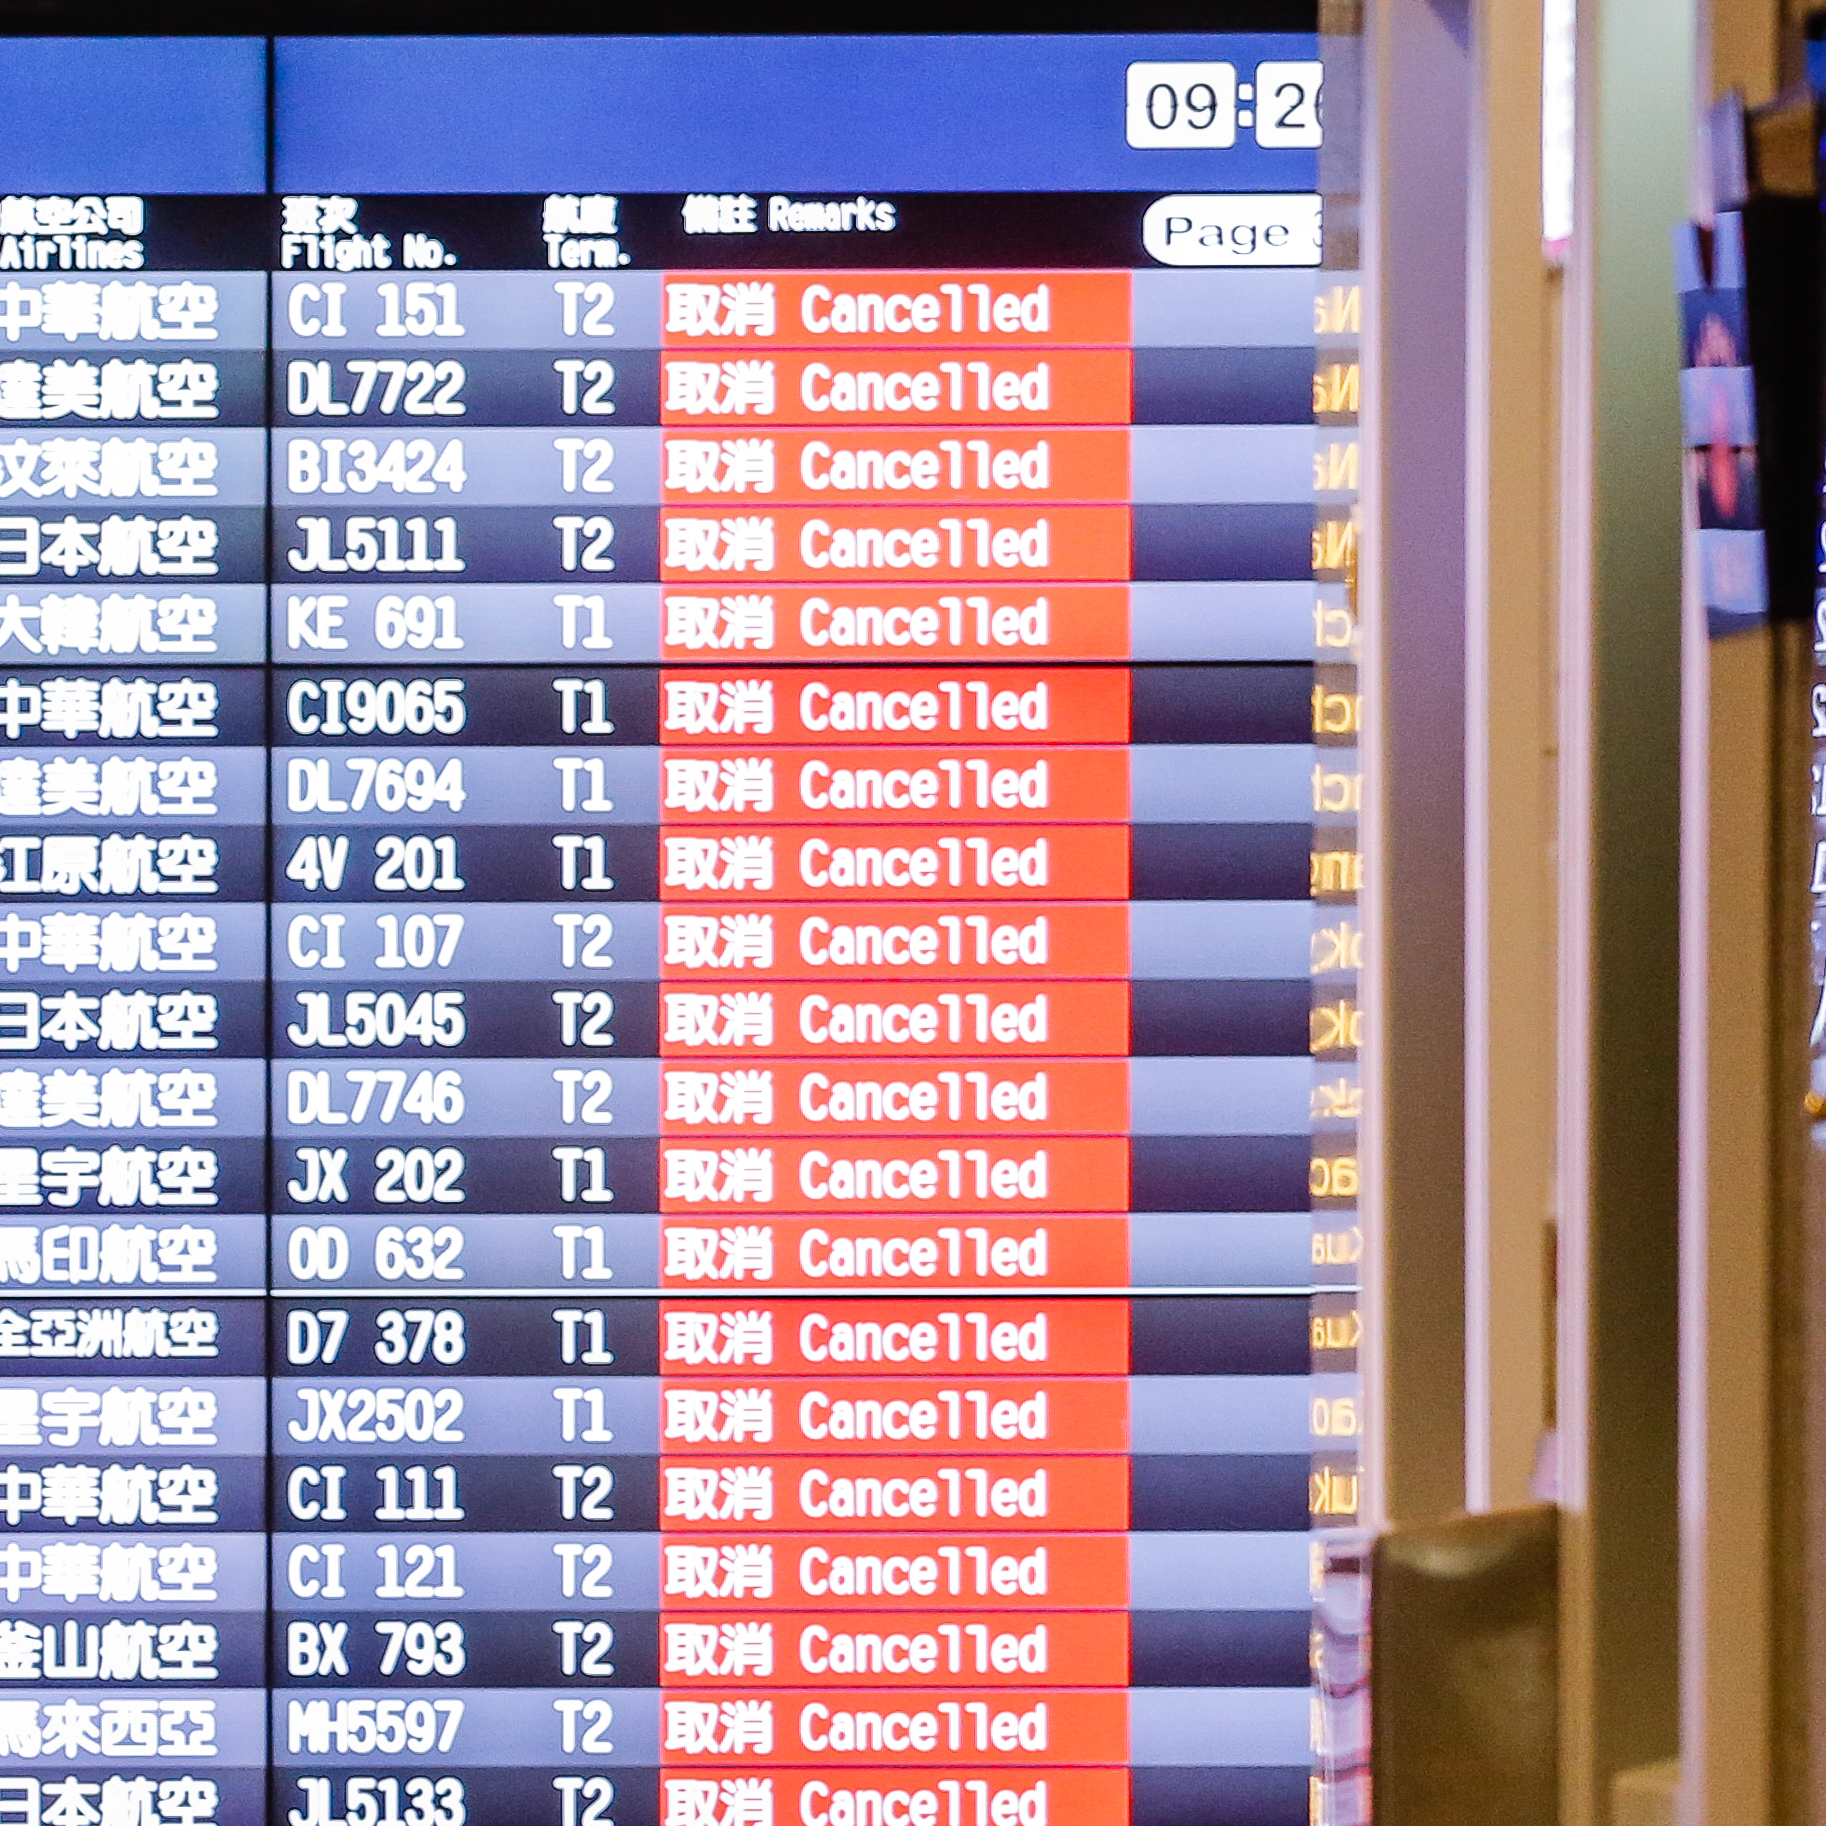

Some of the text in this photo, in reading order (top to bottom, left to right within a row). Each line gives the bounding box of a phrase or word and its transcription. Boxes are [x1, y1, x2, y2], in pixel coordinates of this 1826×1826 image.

[1145, 82, 1324, 131] 09:2
[768, 196, 894, 233] Remarks
[1164, 216, 1290, 255] Page
[282, 234, 455, 273] Flight No.
[543, 234, 629, 269] Term.
[288, 360, 465, 416] DL7722
[553, 359, 614, 415] T2
[664, 359, 775, 416] 取消
[800, 361, 1049, 412] Cancelled
[288, 679, 464, 734] CI9065
[553, 679, 612, 734] T1
[664, 679, 774, 735] 取消
[800, 681, 1048, 732] Cancelled
[286, 836, 349, 890] 4V
[374, 836, 463, 891] 201
[553, 835, 613, 890] T1
[664, 835, 773, 891] 取消
[799, 837, 1047, 888] Cancelled
[287, 991, 465, 1047] JL5045
[553, 991, 612, 1046] T2
[664, 991, 774, 1047] 取消
[799, 993, 1048, 1044] Cancelled
[288, 1310, 348, 1364] D7
[375, 1310, 464, 1364] 378
[553, 1310, 612, 1364] T1
[664, 1310, 773, 1365] 取消
[799, 1312, 1047, 1362] Cancelled
[288, 1465, 345, 1520] CI
[375, 1466, 463, 1520] 111
[553, 1465, 613, 1520] T2
[664, 1465, 773, 1521] 取消
[799, 1468, 1047, 1518] Cancelled
